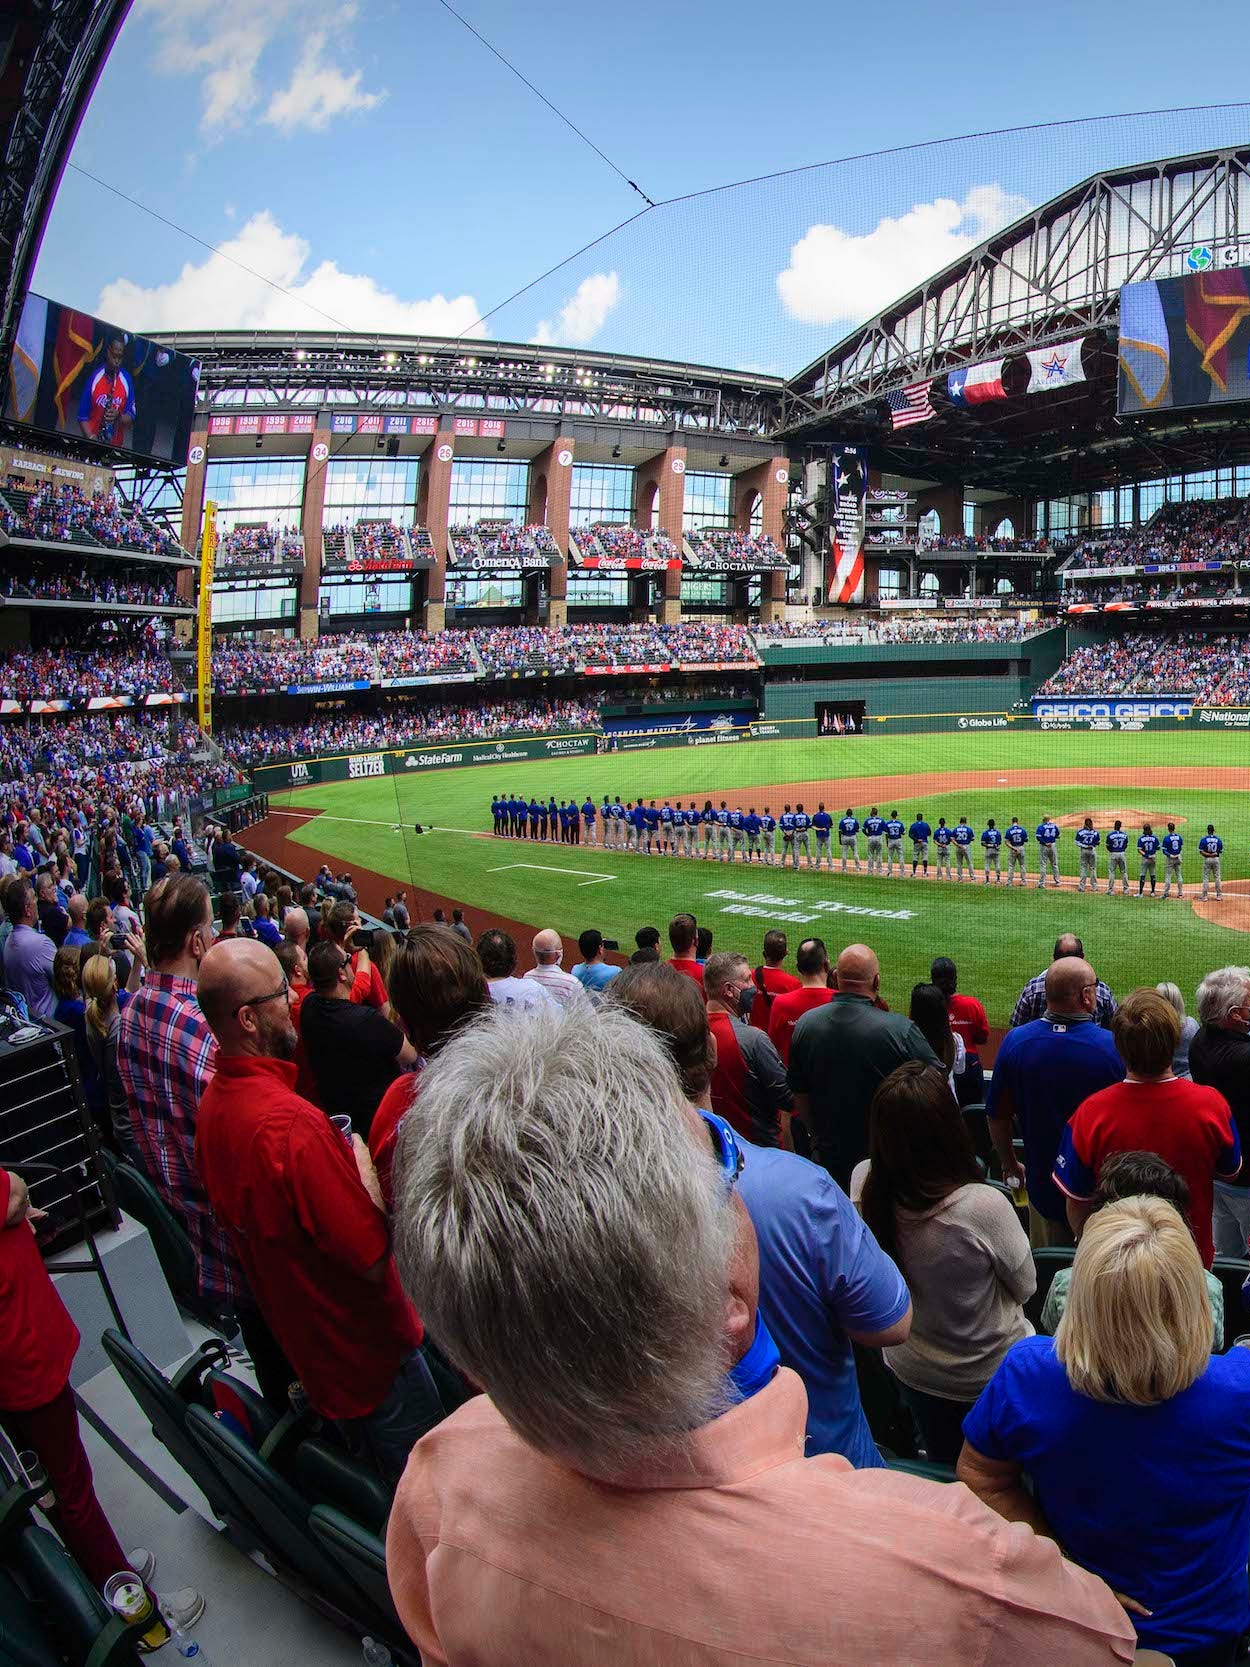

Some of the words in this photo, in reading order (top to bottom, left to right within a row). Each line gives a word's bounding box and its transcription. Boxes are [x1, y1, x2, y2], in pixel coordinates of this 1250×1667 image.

[212, 417, 231, 426] 1996
[240, 416, 259, 425] 1998
[266, 415, 285, 425] 1999
[294, 415, 312, 425] 2010
[335, 416, 353, 425] 2010
[362, 416, 380, 425] 2011
[389, 417, 407, 426] 2011
[416, 417, 434, 426] 2012
[456, 419, 474, 428] 2015
[483, 420, 501, 429] 2016
[191, 450, 203, 461] 42
[315, 447, 326, 457] 34
[439, 448, 451, 458] 26
[562, 454, 569, 464] 7
[673, 462, 684, 471] 29
[778, 471, 786, 480] 10
[522, 556, 550, 568] Bank
[707, 560, 755, 571] CHOCTAW
[1037, 704, 1110, 722] GEICO
[1115, 703, 1190, 722] GEICO
[1211, 710, 1250, 722] National
[969, 718, 992, 727] Globe
[993, 717, 1008, 727] Life
[549, 739, 590, 749] CHOCTAW
[694, 735, 716, 745] planet
[717, 734, 740, 743] fitness
[291, 763, 309, 778] UTA
[349, 761, 385, 779] SELTZER
[808, 901, 919, 920] Truck
